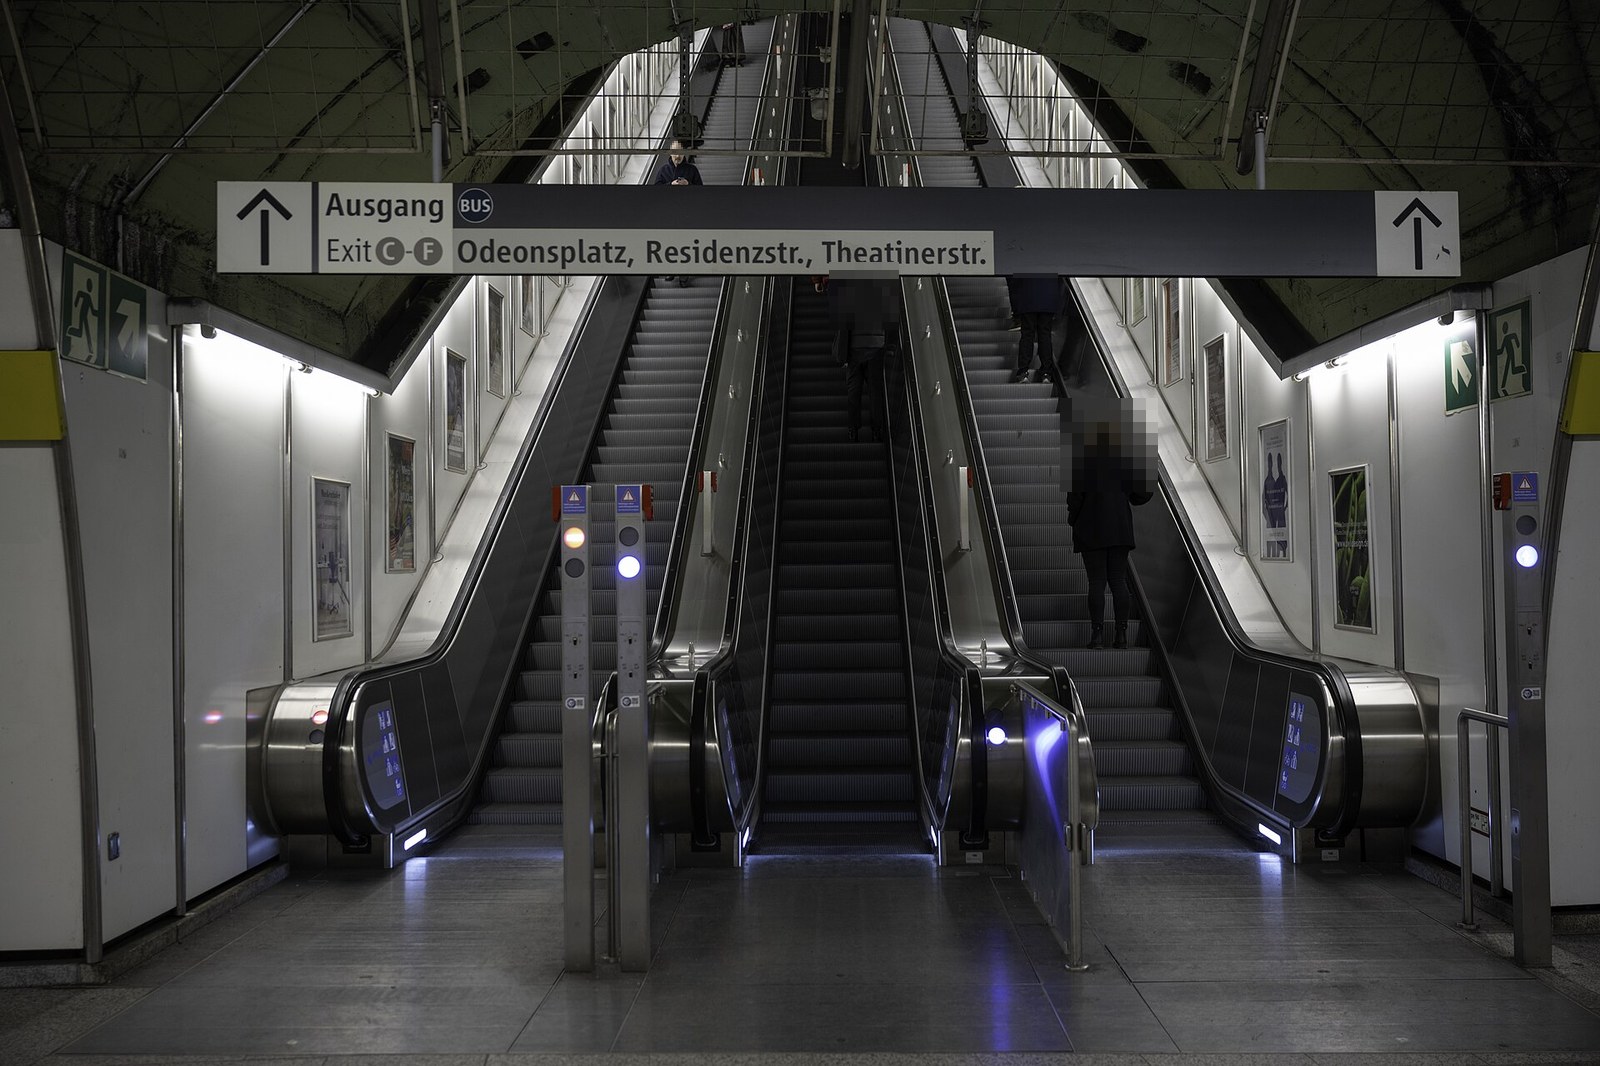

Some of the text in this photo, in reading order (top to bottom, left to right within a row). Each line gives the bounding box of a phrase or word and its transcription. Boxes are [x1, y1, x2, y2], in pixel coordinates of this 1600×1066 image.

[325, 192, 444, 223] Ausgang
[460, 198, 491, 213] BUS
[327, 238, 372, 263] Exit
[457, 238, 987, 269] Odeonsplatz, Residenzstr., Theatinerstr.
